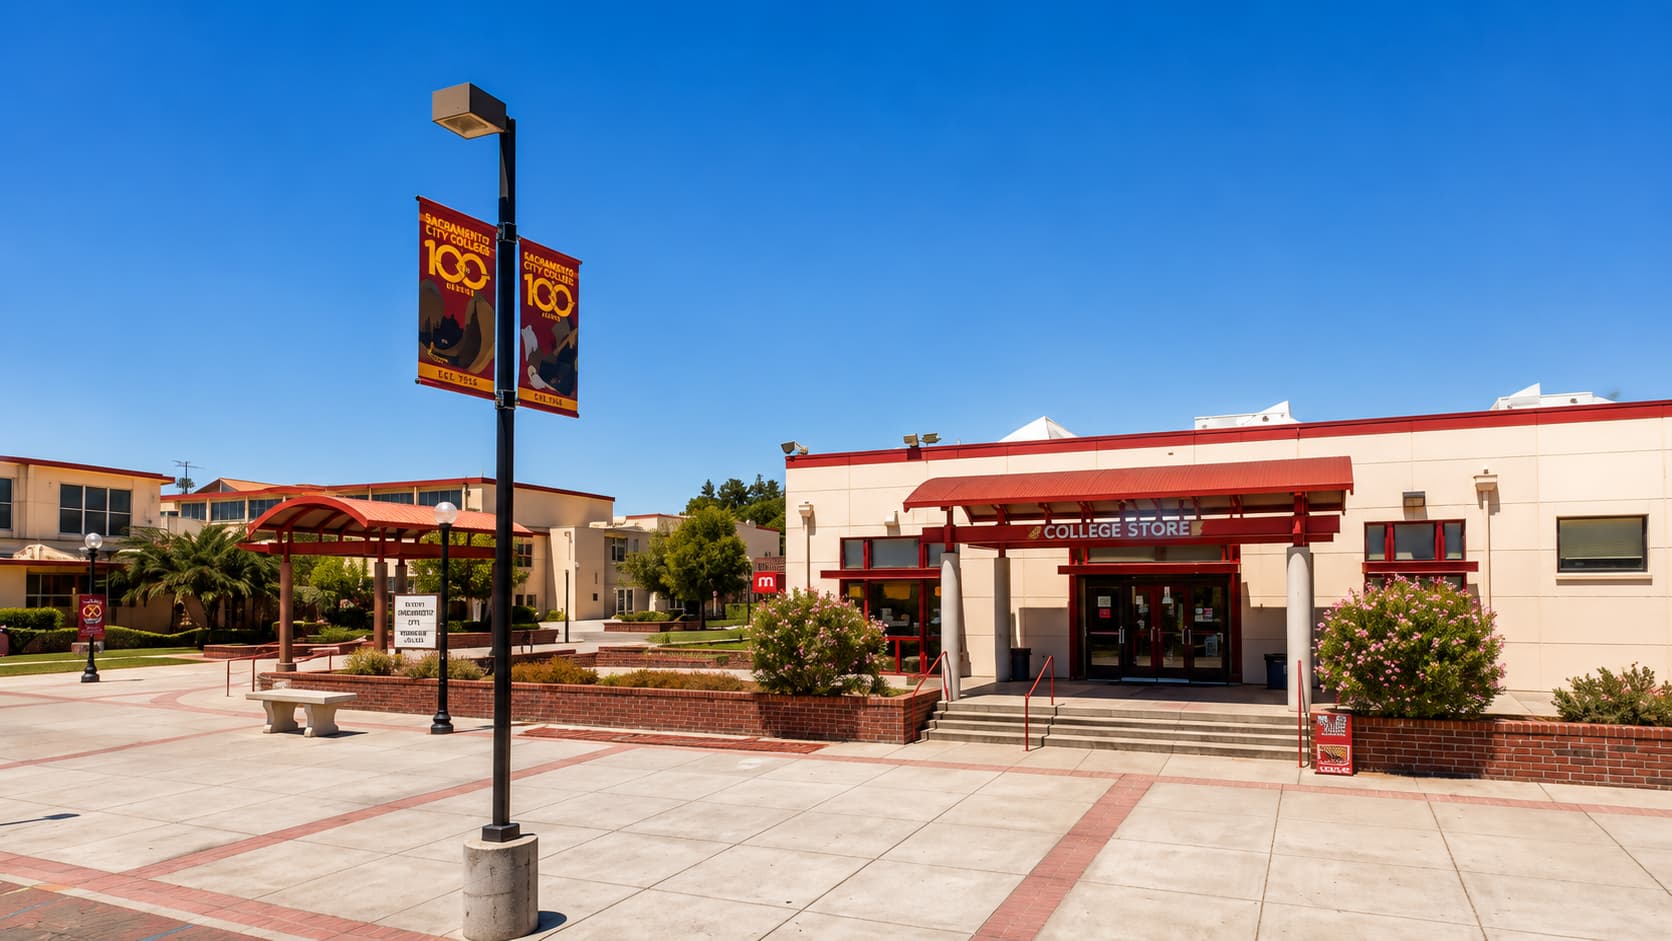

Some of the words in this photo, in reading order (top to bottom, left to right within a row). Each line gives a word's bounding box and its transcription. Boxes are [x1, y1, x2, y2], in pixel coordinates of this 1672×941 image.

[425, 213, 490, 245] SACRAMENTO
[426, 225, 448, 241] CITY
[424, 240, 491, 291] 100
[524, 261, 544, 274] CITY
[524, 273, 575, 317] 100
[1044, 523, 1121, 539] COLLEGE
[1128, 521, 1190, 537] STORE
